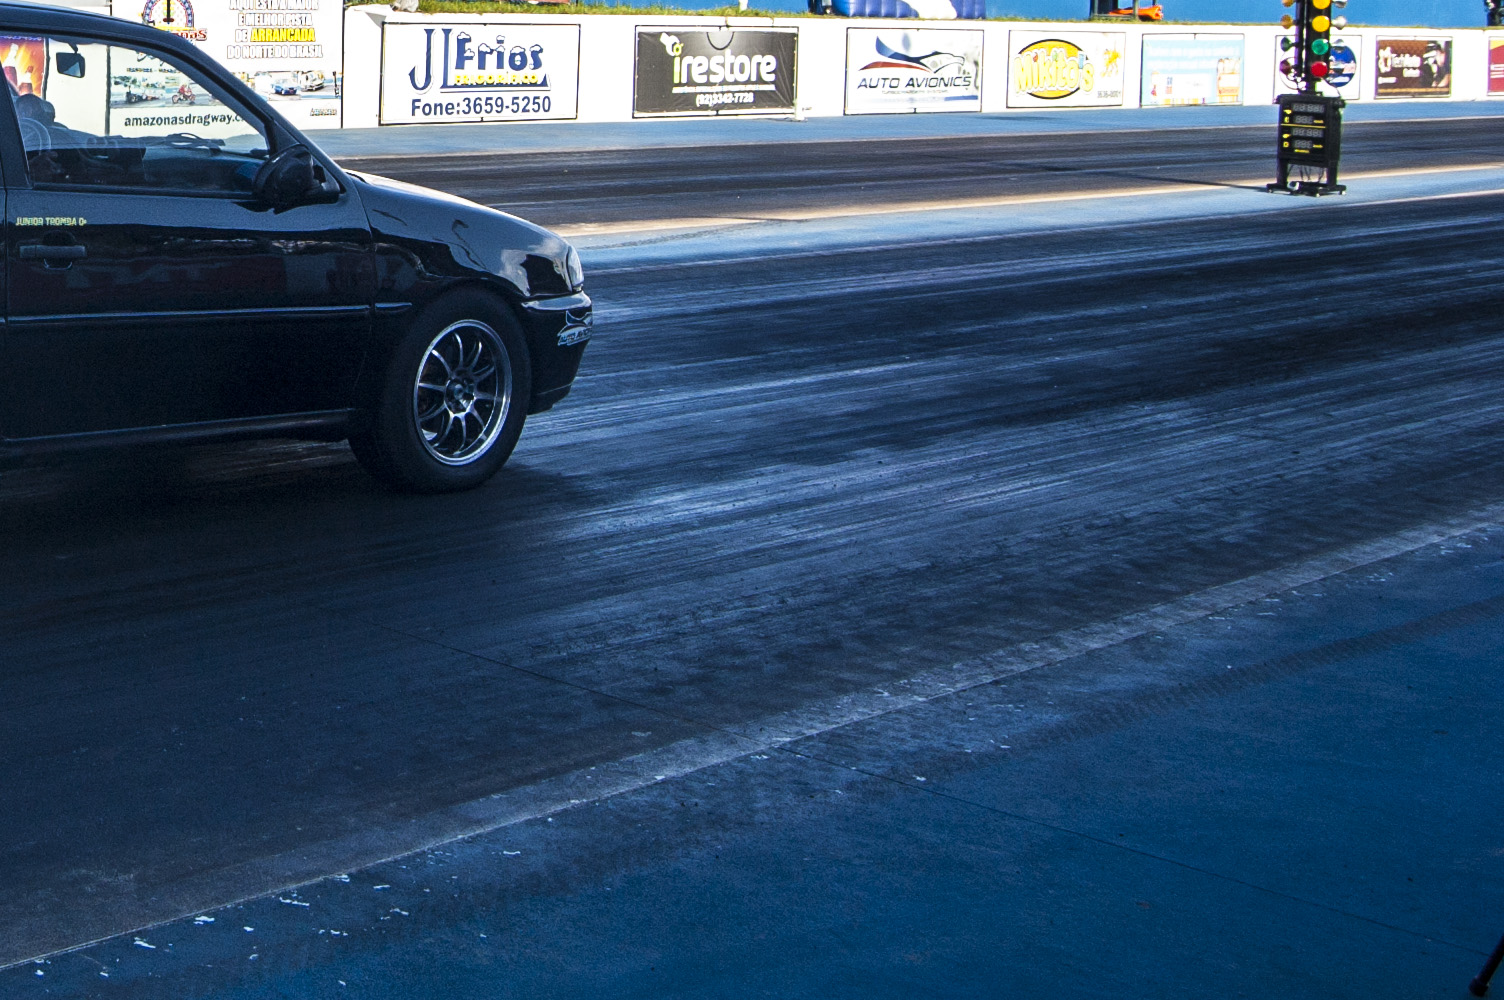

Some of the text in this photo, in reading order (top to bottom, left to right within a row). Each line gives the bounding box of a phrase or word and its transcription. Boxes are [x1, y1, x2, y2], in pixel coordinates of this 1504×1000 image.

[238, 13, 313, 26] E MELHOR PISTA
[235, 28, 316, 42] DE ARRANCADA
[227, 45, 323, 59] DO NORTE DO BRASIL
[455, 31, 543, 71] Frios
[673, 42, 777, 84] irestore
[1014, 50, 1095, 94] Mikito's
[857, 75, 972, 90] AUTO AVIONICS
[411, 95, 551, 117] Fone:3659-5250
[124, 113, 244, 127] amazonasdragway.c
